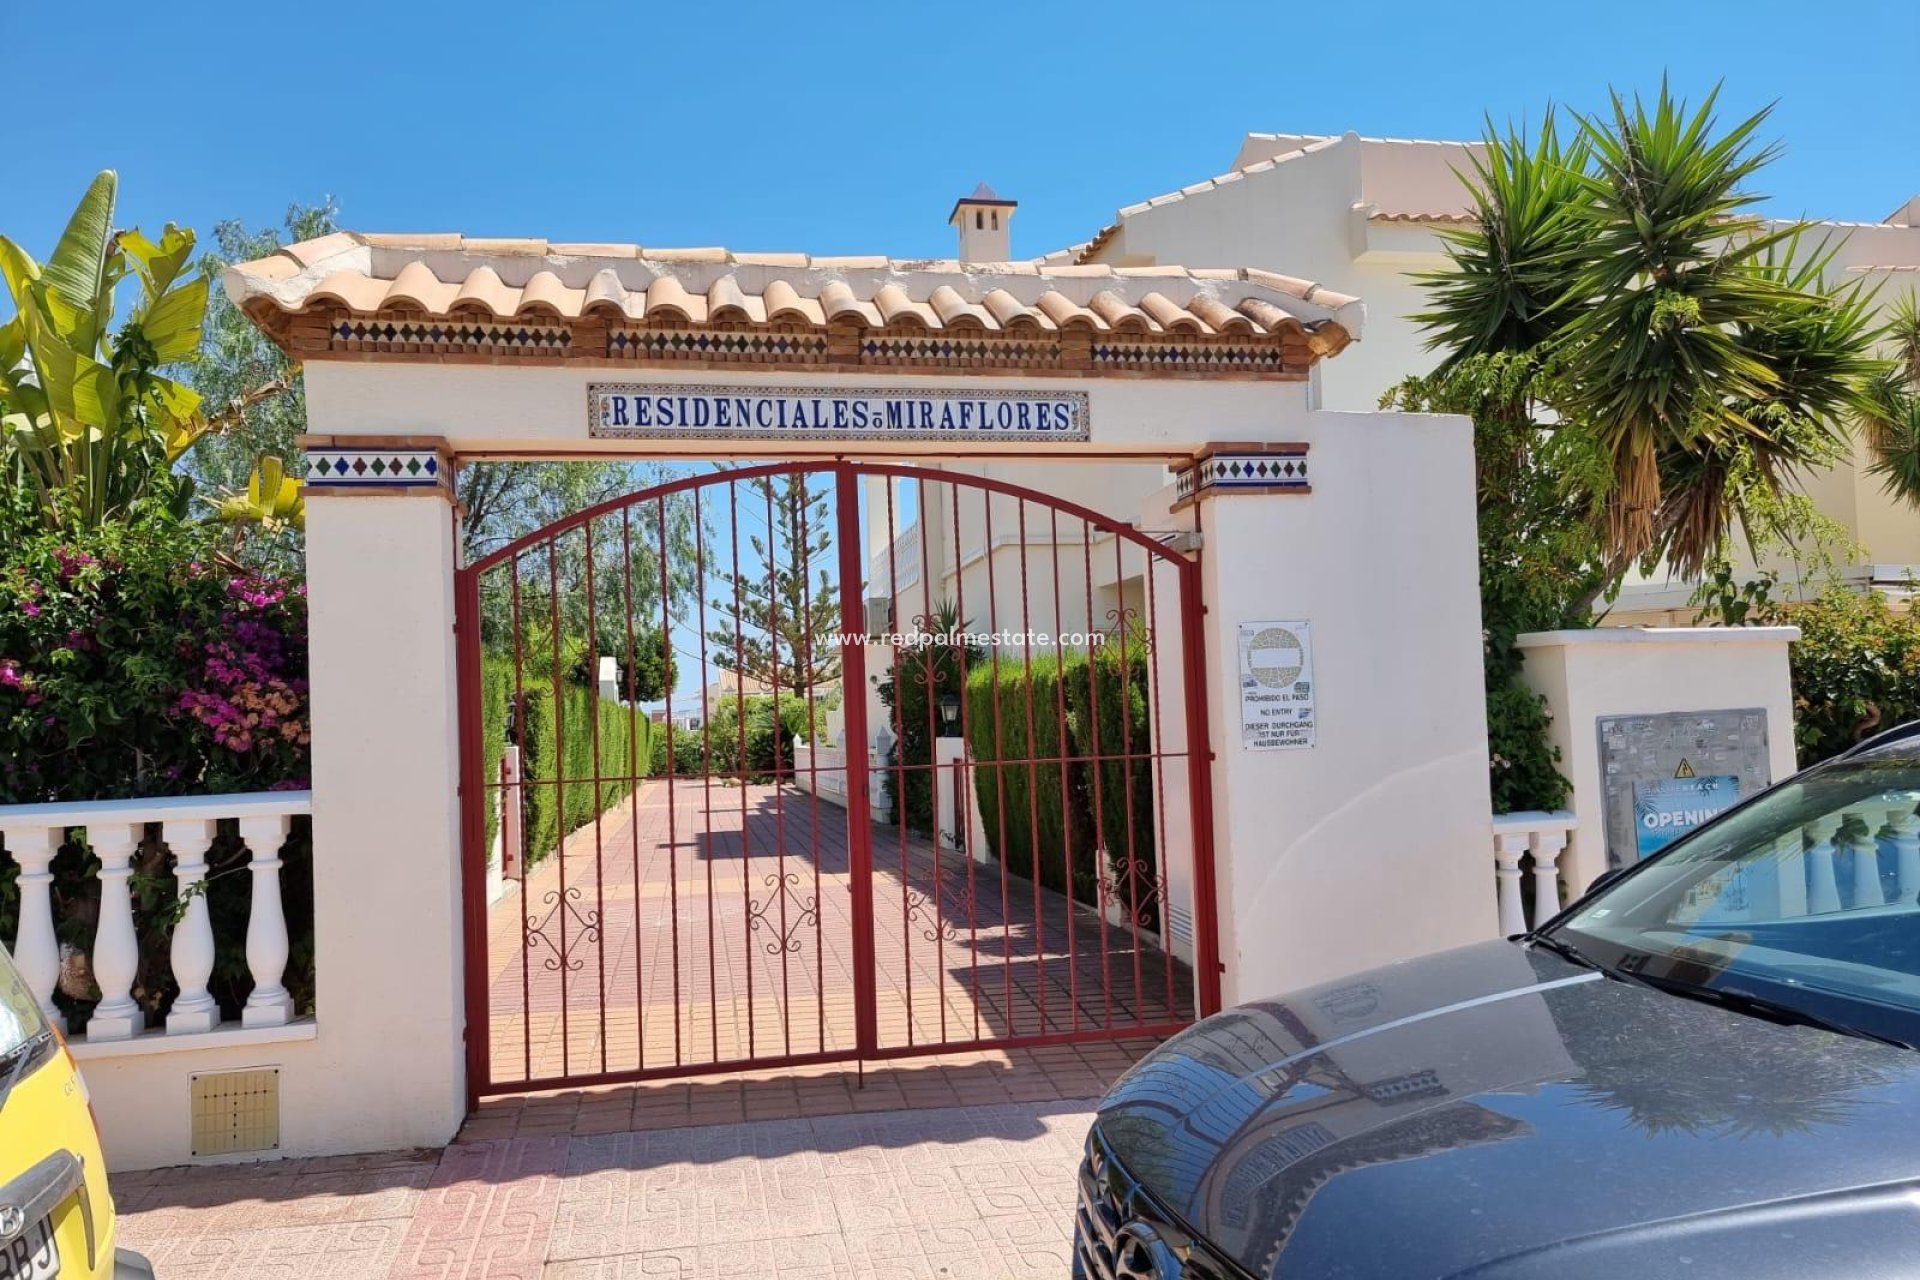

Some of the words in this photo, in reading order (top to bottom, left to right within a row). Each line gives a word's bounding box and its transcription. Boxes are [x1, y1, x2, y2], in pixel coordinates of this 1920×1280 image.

[611, 396, 869, 429] RESIDENCIALES
[886, 400, 1069, 430] MIRAFLORES
[1245, 694, 1281, 702] PROHIBIDO
[1292, 693, 1309, 701] PASO
[1260, 708, 1271, 716] NO
[1271, 708, 1293, 716] ENTRY
[1643, 808, 1728, 829] OPENIN
